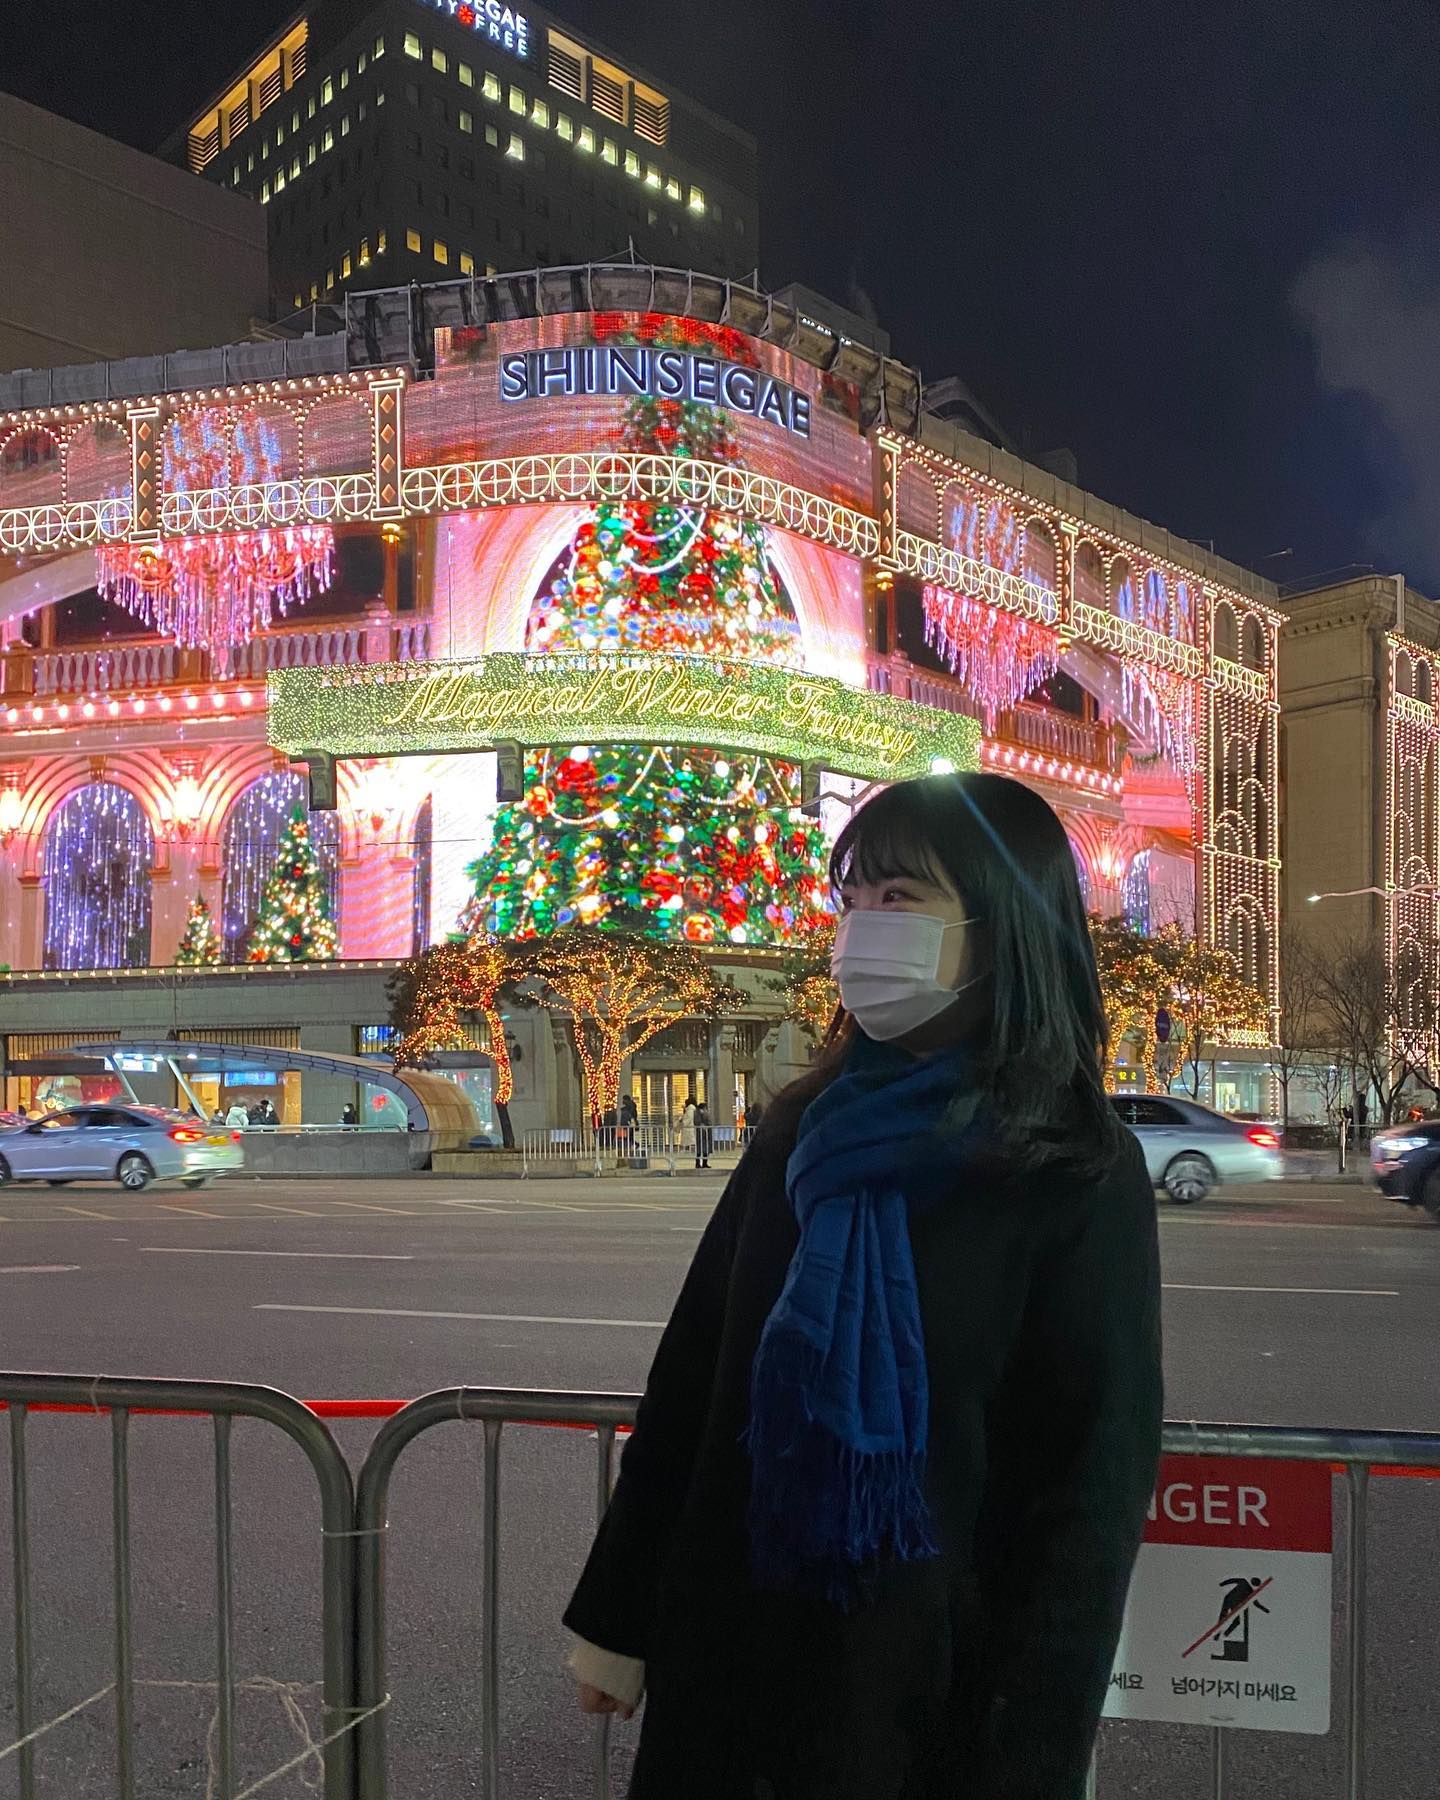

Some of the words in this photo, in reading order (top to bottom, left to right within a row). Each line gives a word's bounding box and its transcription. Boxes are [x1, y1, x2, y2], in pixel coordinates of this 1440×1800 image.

[474, 13, 528, 56] FREE
[502, 347, 809, 438] SHINSEGAE
[383, 665, 609, 737] Magical
[611, 663, 775, 721] Winter
[781, 680, 916, 766] Fantasy
[1171, 1676, 1239, 1699] 넘어가지
[1244, 1681, 1298, 1701] 마세요
